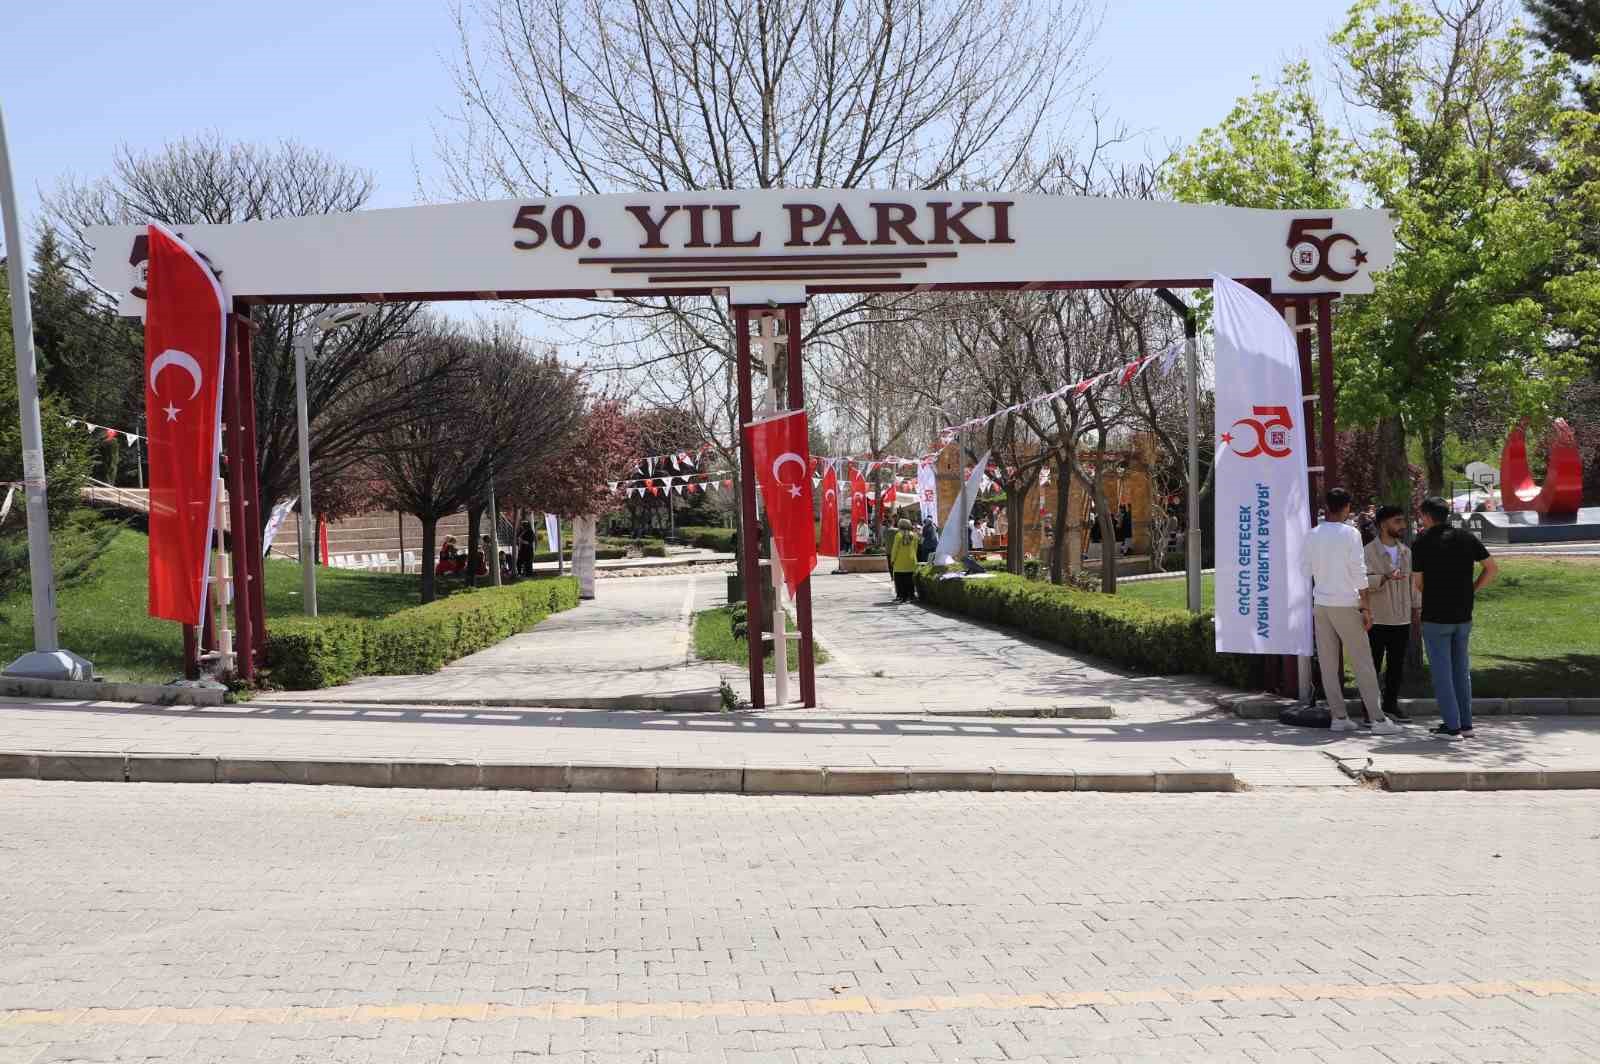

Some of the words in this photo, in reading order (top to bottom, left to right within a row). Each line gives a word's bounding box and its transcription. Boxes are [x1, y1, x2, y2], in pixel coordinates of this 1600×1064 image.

[513, 205, 601, 250] 50.
[625, 204, 760, 249] YIL
[782, 202, 1015, 247] PARKI
